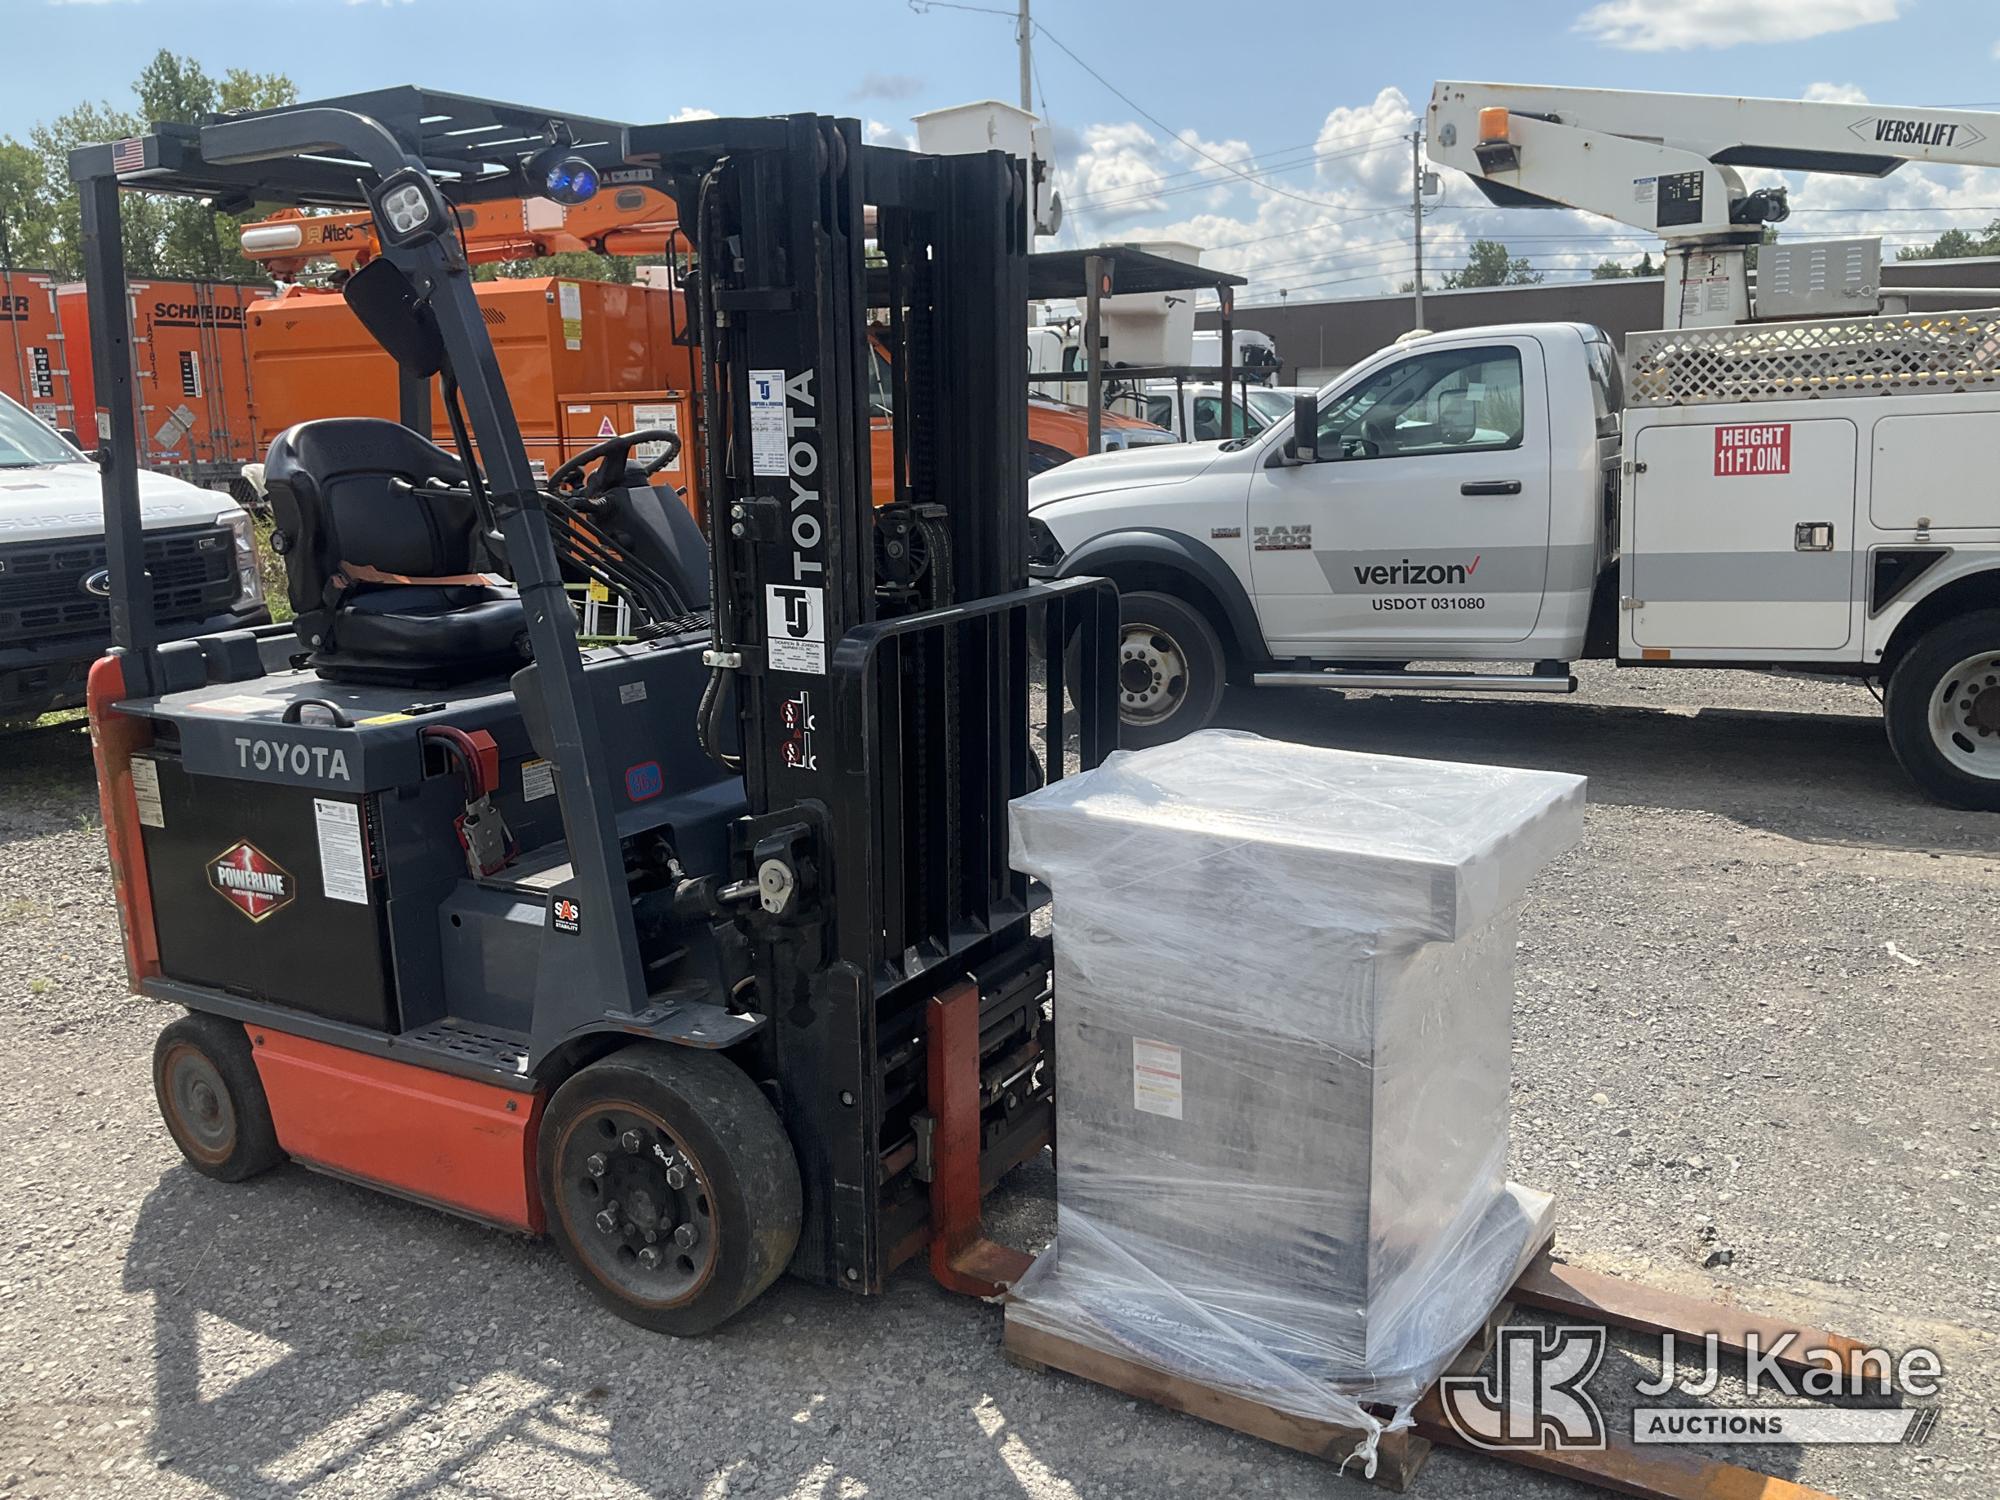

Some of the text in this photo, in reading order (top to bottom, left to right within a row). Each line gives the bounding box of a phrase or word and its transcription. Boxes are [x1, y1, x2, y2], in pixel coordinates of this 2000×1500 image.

[1875, 118, 1959, 147] VERSALIFT
[322, 224, 354, 244] Altec
[154, 303, 248, 321] SCHNEIDE
[1722, 427, 1785, 446] HEIGHT
[785, 368, 823, 581] TOYOTA
[1254, 525, 1311, 535] RAM
[1254, 535, 1312, 544] 4500
[1354, 559, 1465, 585] verizon
[1372, 597, 1485, 611] USDOT 031080
[235, 738, 350, 781] TOYOTA
[218, 867, 285, 895] POWERLINE
[554, 900, 579, 921] SAS
